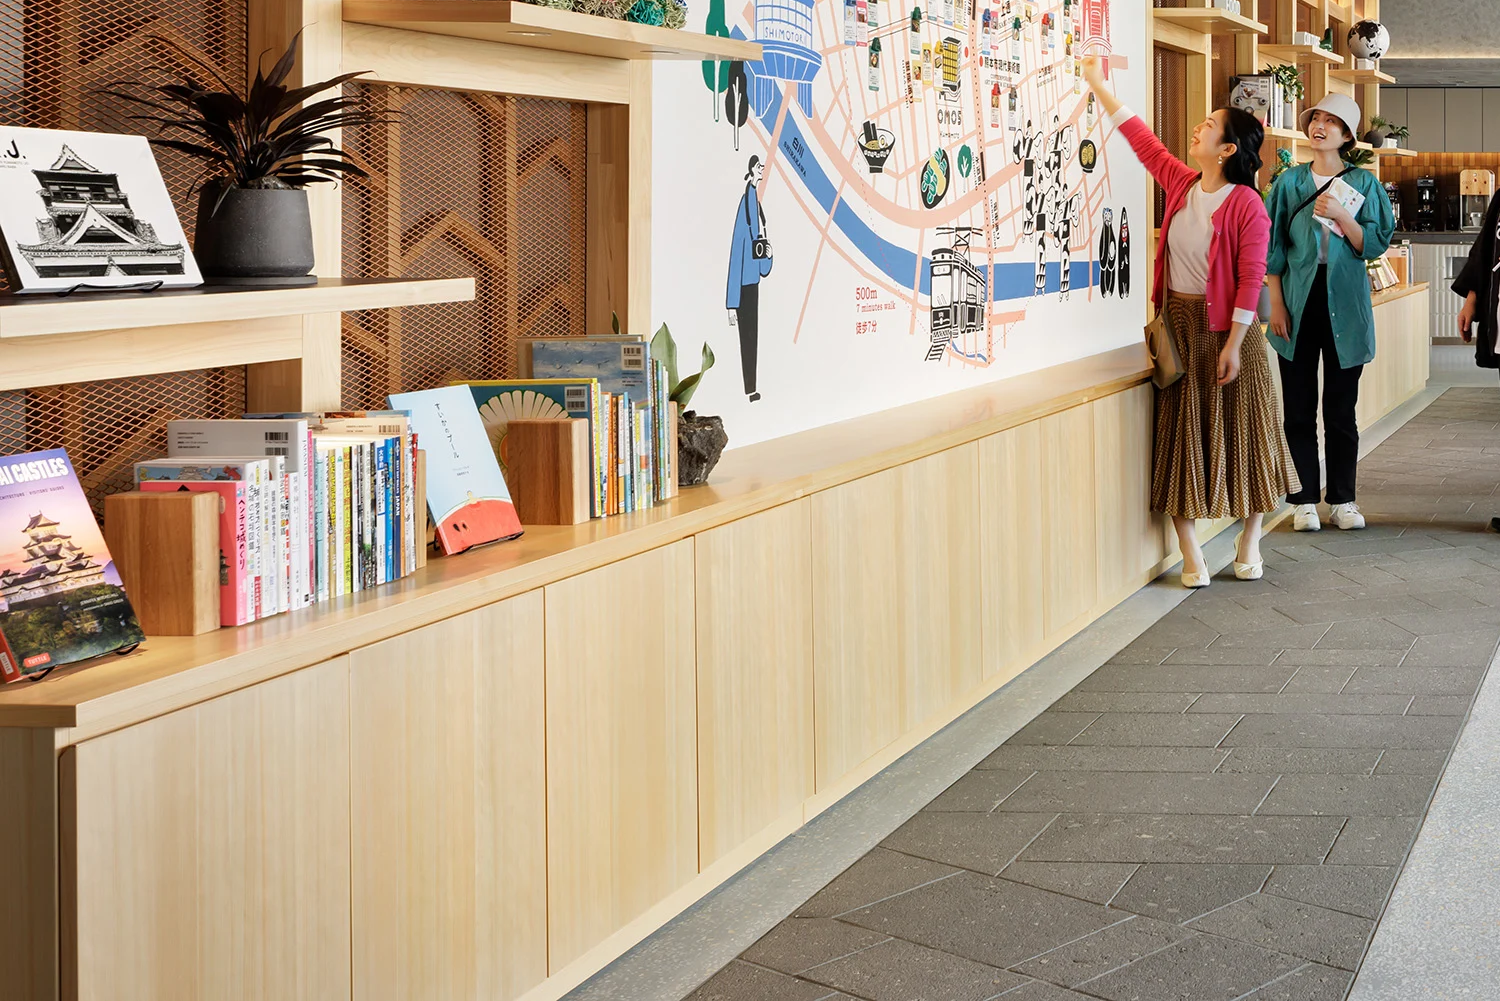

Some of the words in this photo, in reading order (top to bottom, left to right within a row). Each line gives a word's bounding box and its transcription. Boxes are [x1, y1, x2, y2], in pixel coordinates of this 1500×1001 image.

[937, 110, 962, 125] OMO5
[792, 136, 805, 159] 白川
[855, 286, 878, 300] 500m
[861, 302, 883, 313] minutes
[883, 301, 896, 311] walk
[855, 320, 878, 334] 徒歩7分
[11, 457, 69, 483] CASTLES
[1, 654, 12, 673] TUTTLE
[28, 655, 47, 666] TUTTLE
